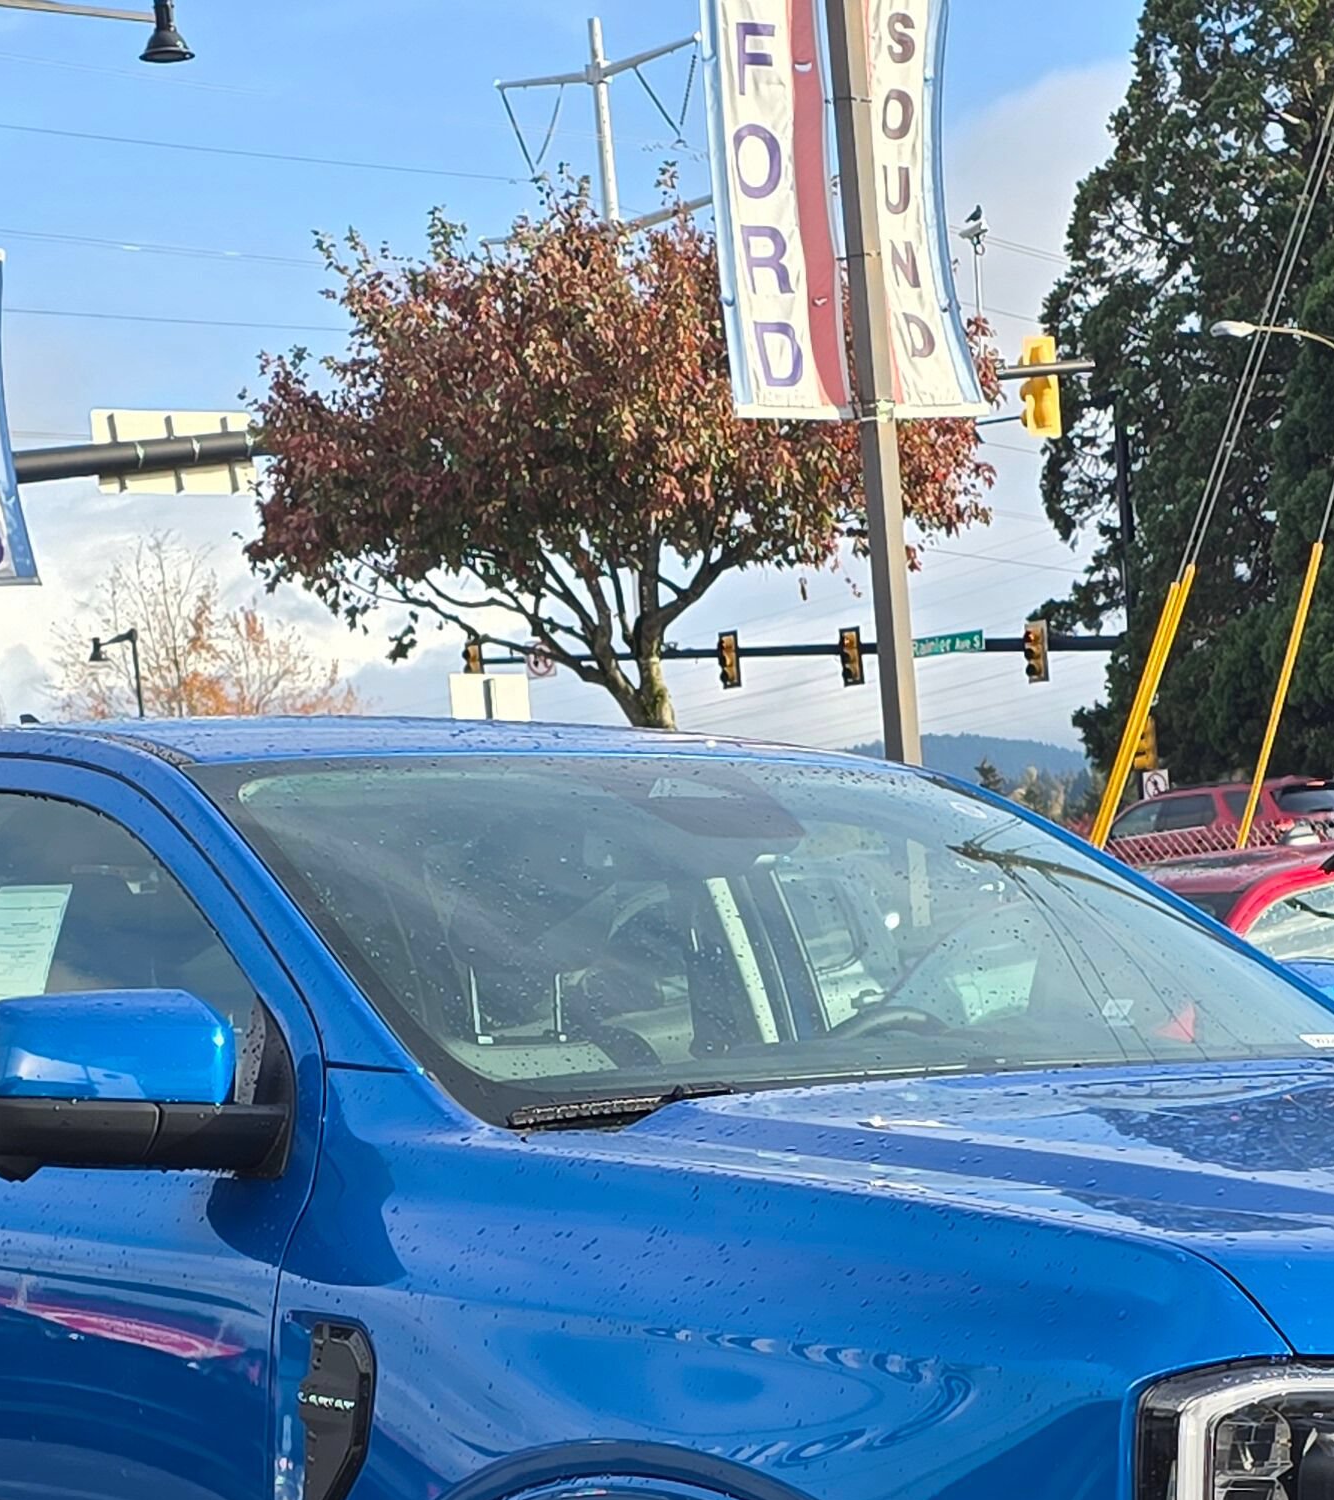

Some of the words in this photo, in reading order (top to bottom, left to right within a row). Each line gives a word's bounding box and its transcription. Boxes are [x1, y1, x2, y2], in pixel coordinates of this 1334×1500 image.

[732, 22, 803, 387] FORD
[881, 12, 935, 358] SOUND
[973, 635, 981, 650] S
